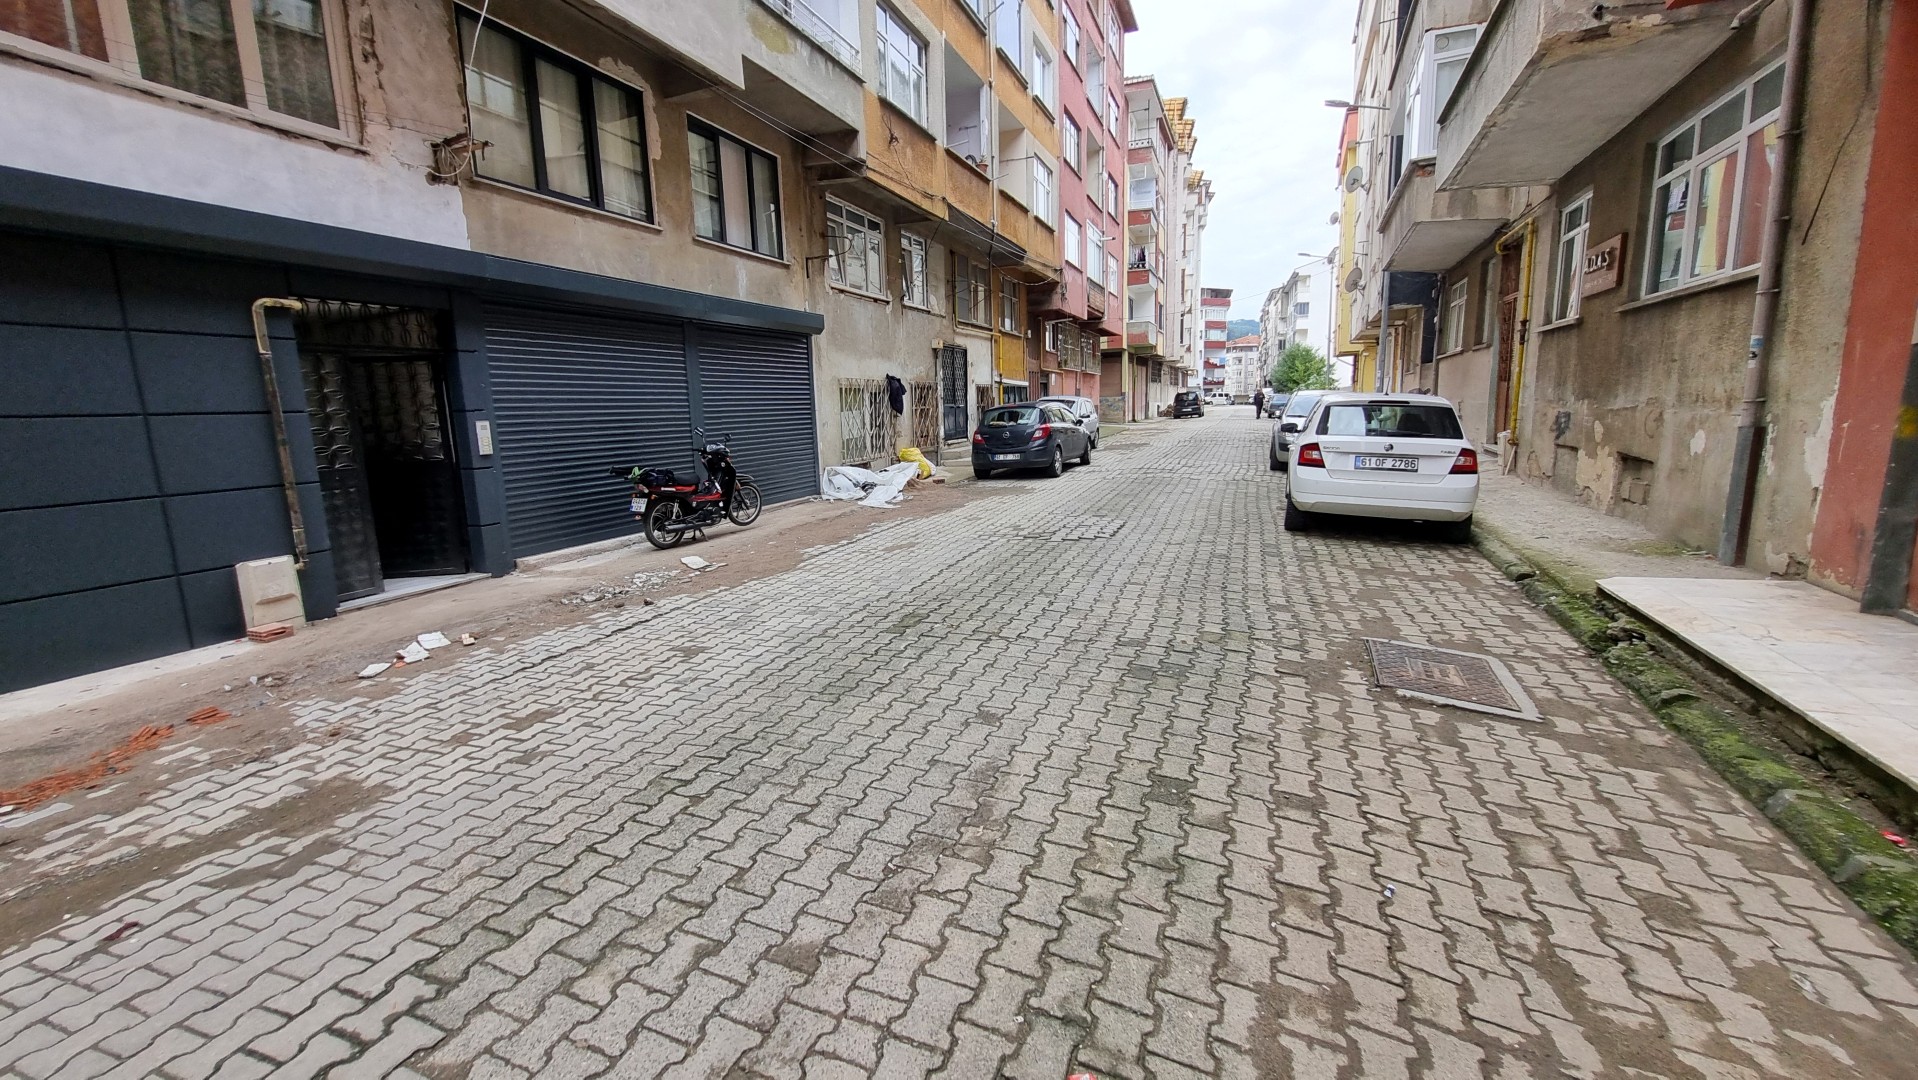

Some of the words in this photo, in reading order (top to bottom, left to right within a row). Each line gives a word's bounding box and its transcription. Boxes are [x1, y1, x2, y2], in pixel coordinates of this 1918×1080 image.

[1361, 458, 1372, 467] 61
[1375, 458, 1388, 467] OF
[1391, 459, 1417, 469] 2786
